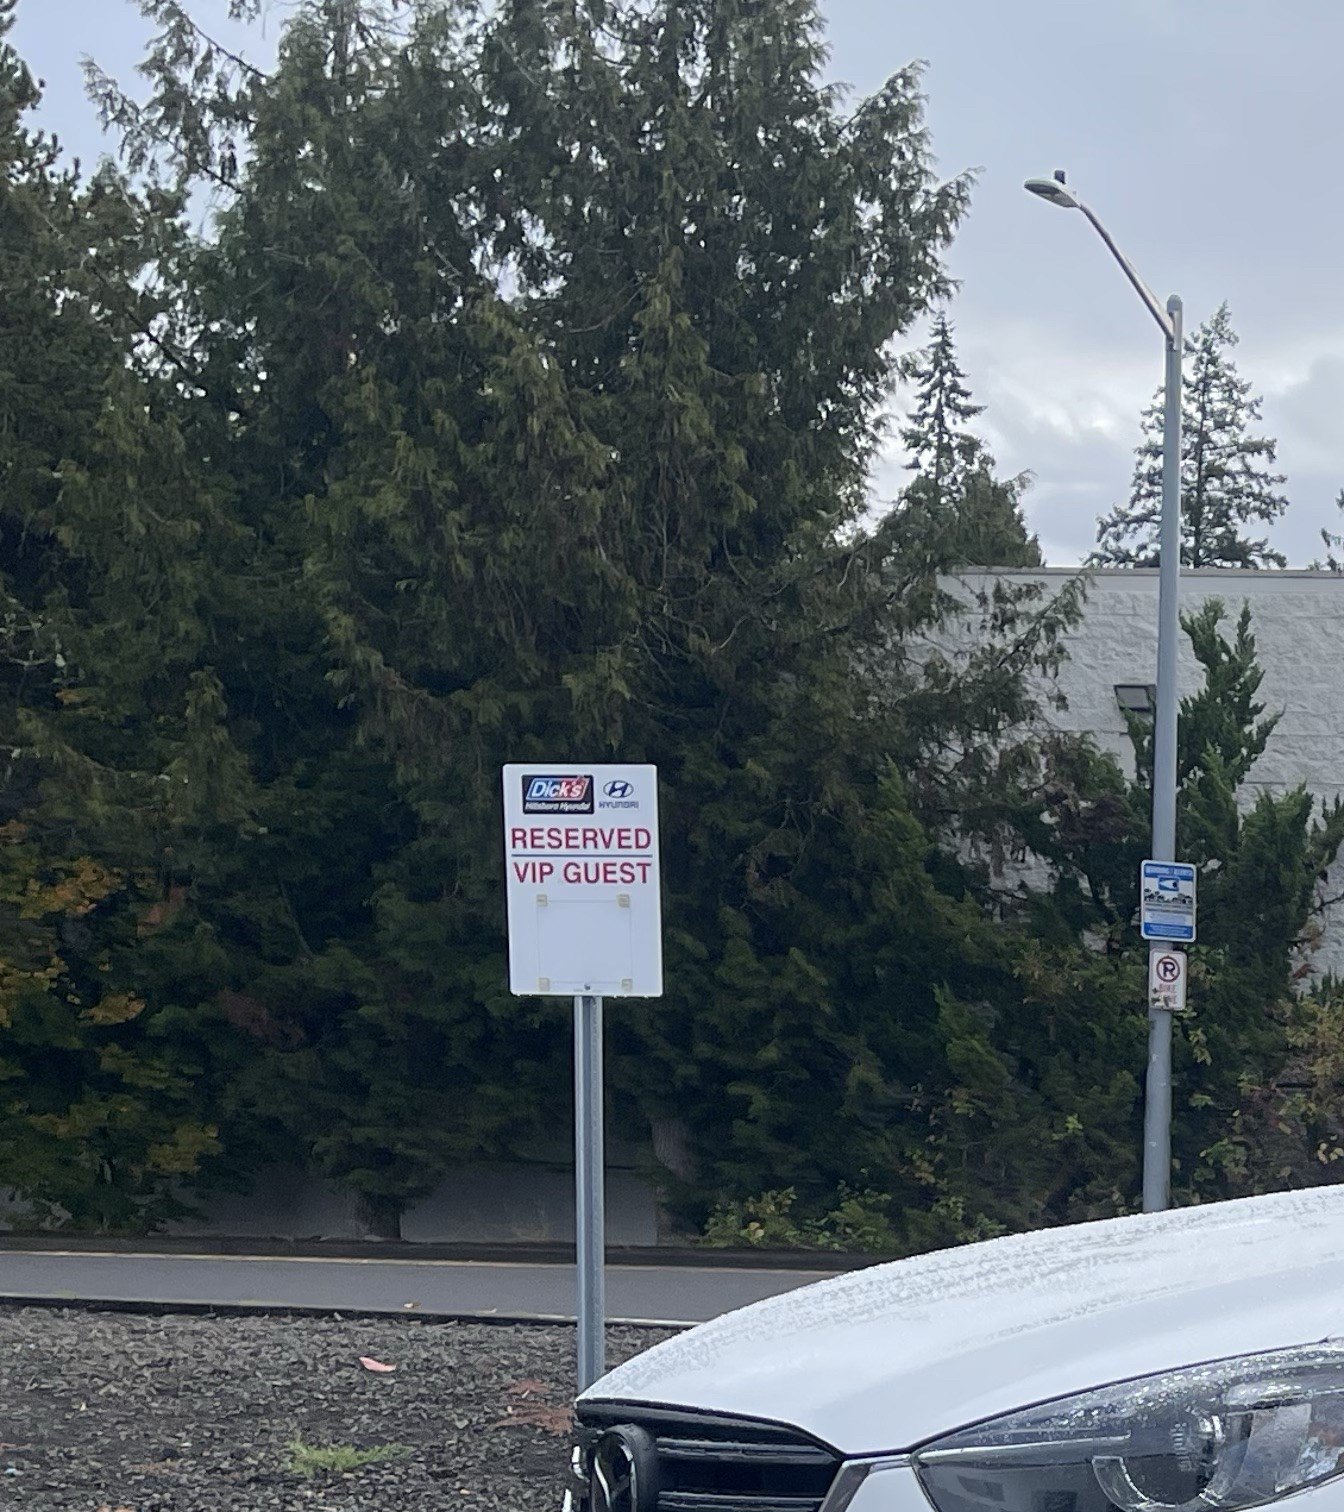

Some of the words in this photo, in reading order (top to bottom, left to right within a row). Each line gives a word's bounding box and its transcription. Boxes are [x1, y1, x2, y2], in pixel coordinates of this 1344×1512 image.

[599, 800, 640, 809] HYUNDAI
[511, 827, 651, 850] RESERVED
[513, 861, 554, 884] VIP
[563, 861, 652, 884] GUEST
